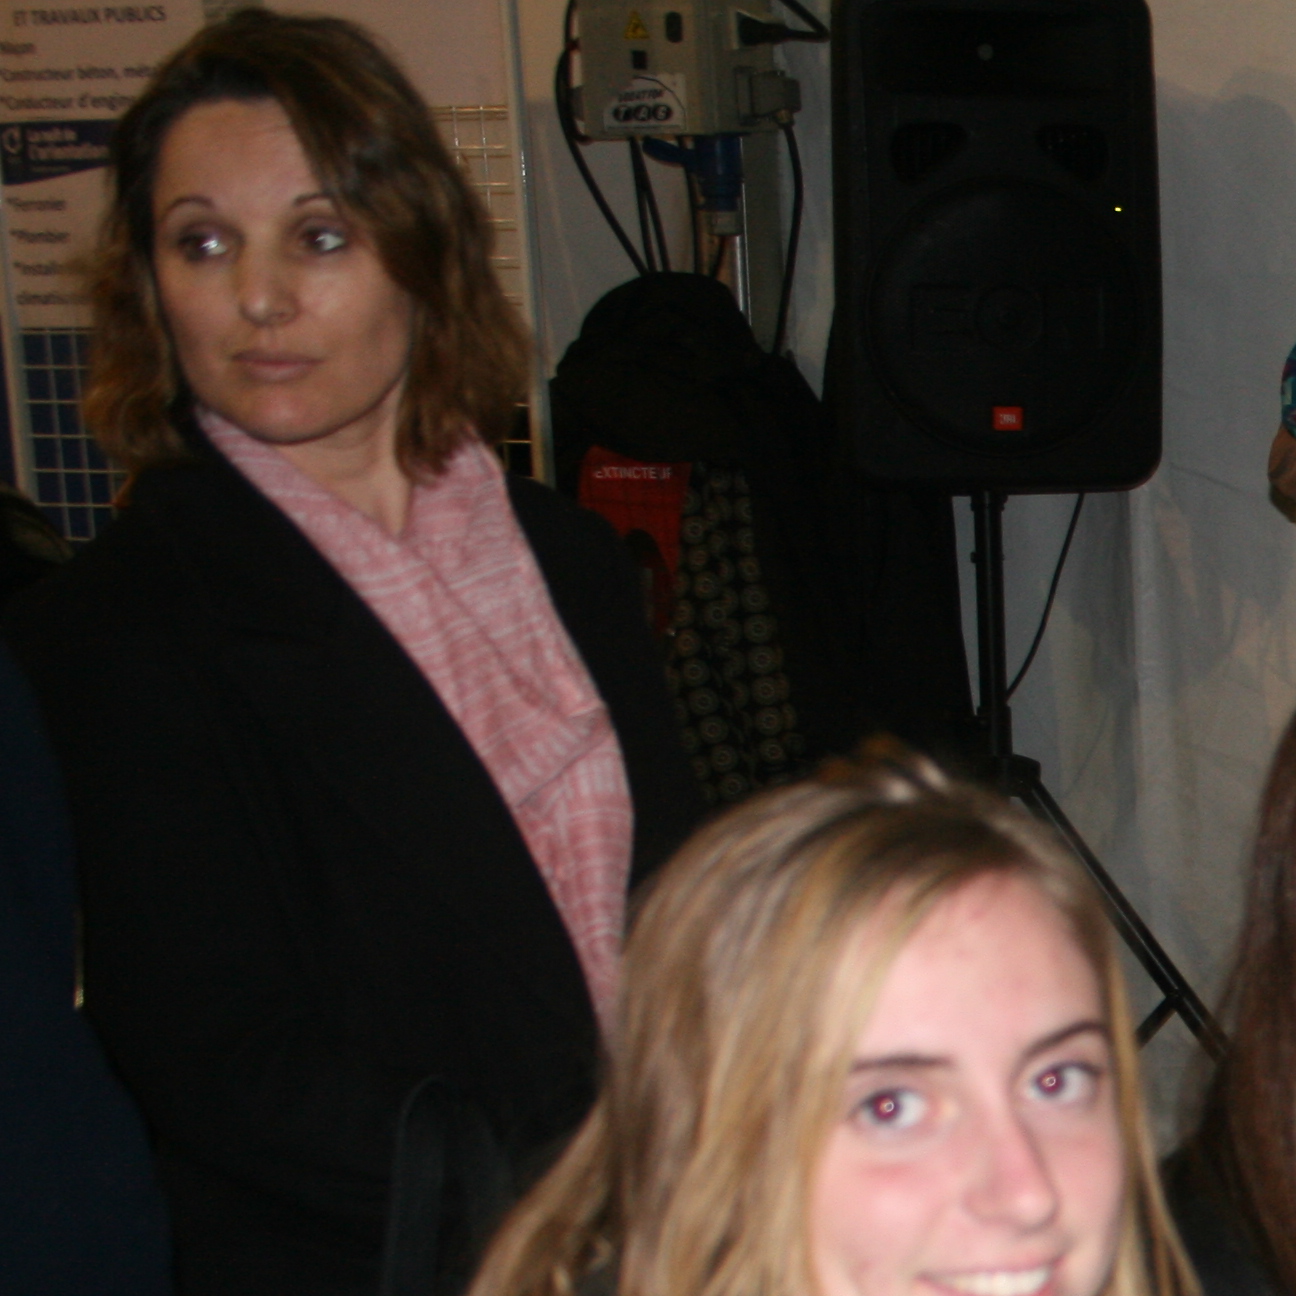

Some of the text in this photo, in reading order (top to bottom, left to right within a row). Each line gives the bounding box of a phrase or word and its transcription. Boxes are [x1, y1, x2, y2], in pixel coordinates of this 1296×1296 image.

[12, 5, 167, 27] ET TRAVAUX PUBLICS
